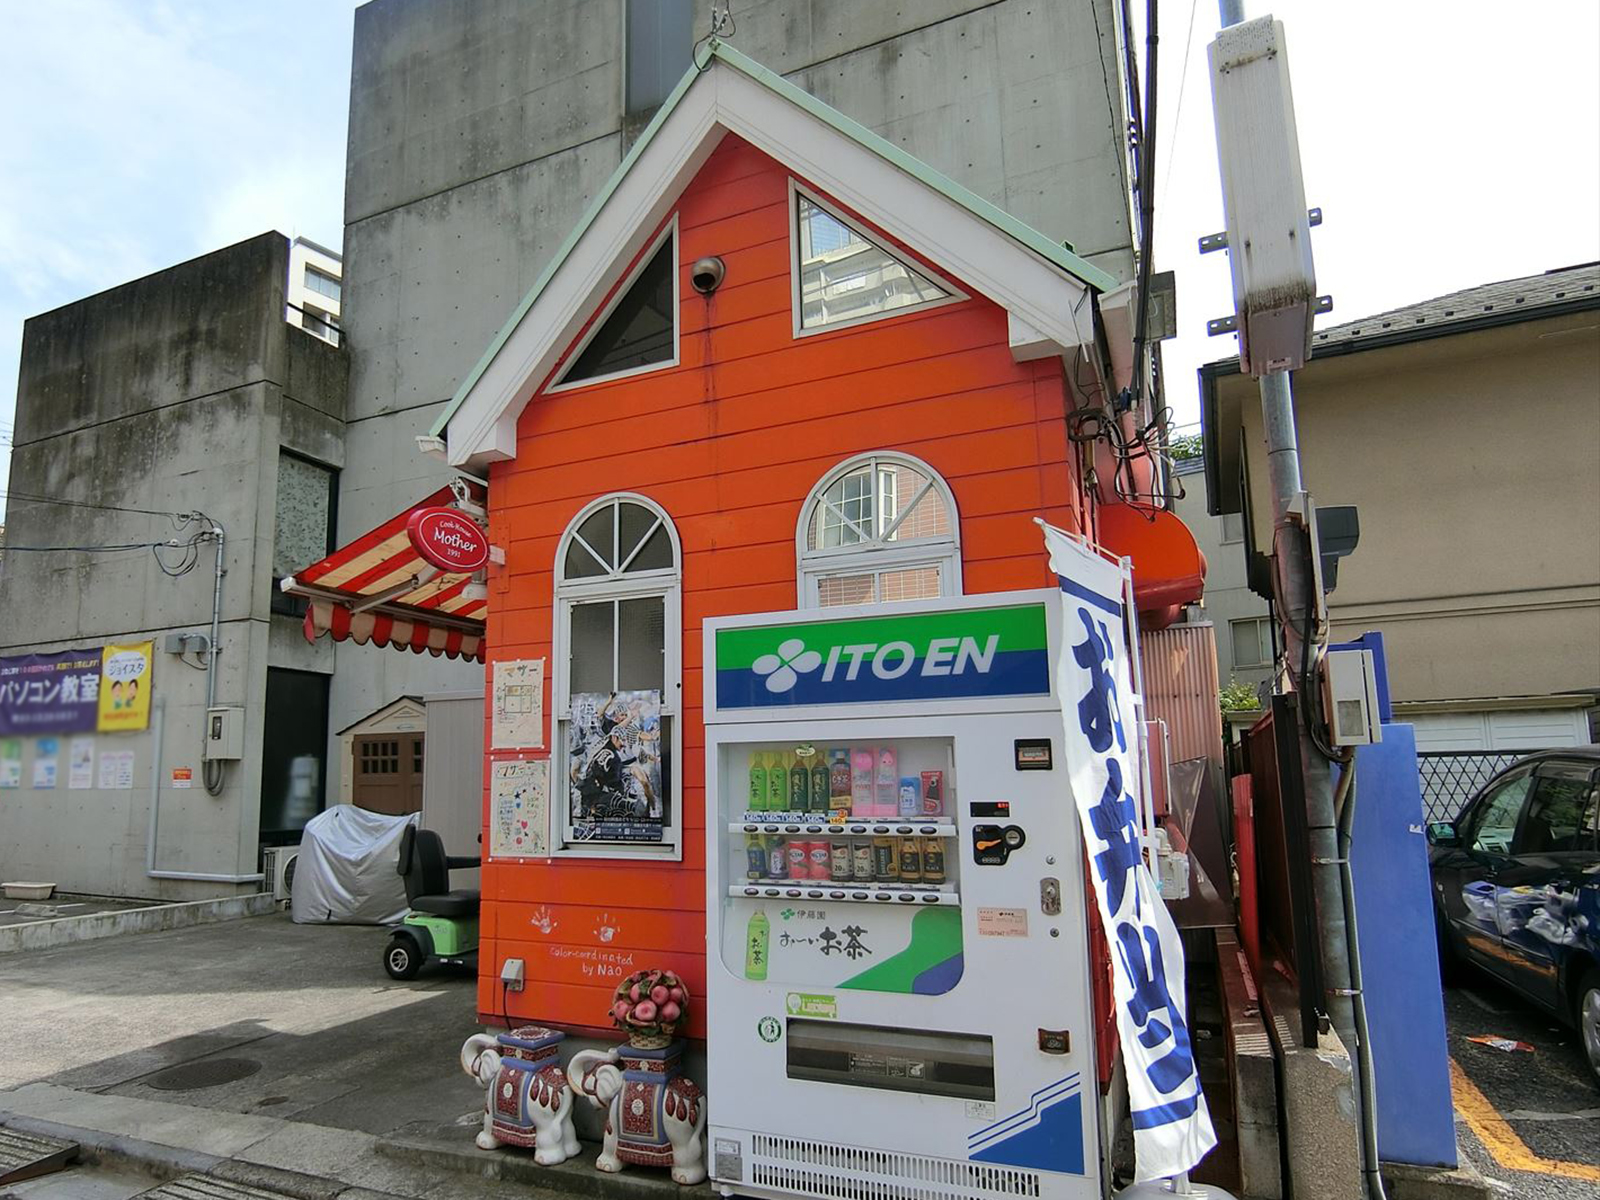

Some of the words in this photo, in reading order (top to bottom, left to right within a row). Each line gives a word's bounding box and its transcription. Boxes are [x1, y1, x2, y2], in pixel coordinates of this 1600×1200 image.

[434, 526, 478, 553] Mother
[821, 640, 916, 683] ITO
[920, 634, 1000, 677] EN
[0, 673, 100, 706] パソコン教室
[796, 909, 826, 920] 伊藤園
[582, 962, 594, 976] by
[597, 963, 623, 976] Nao
